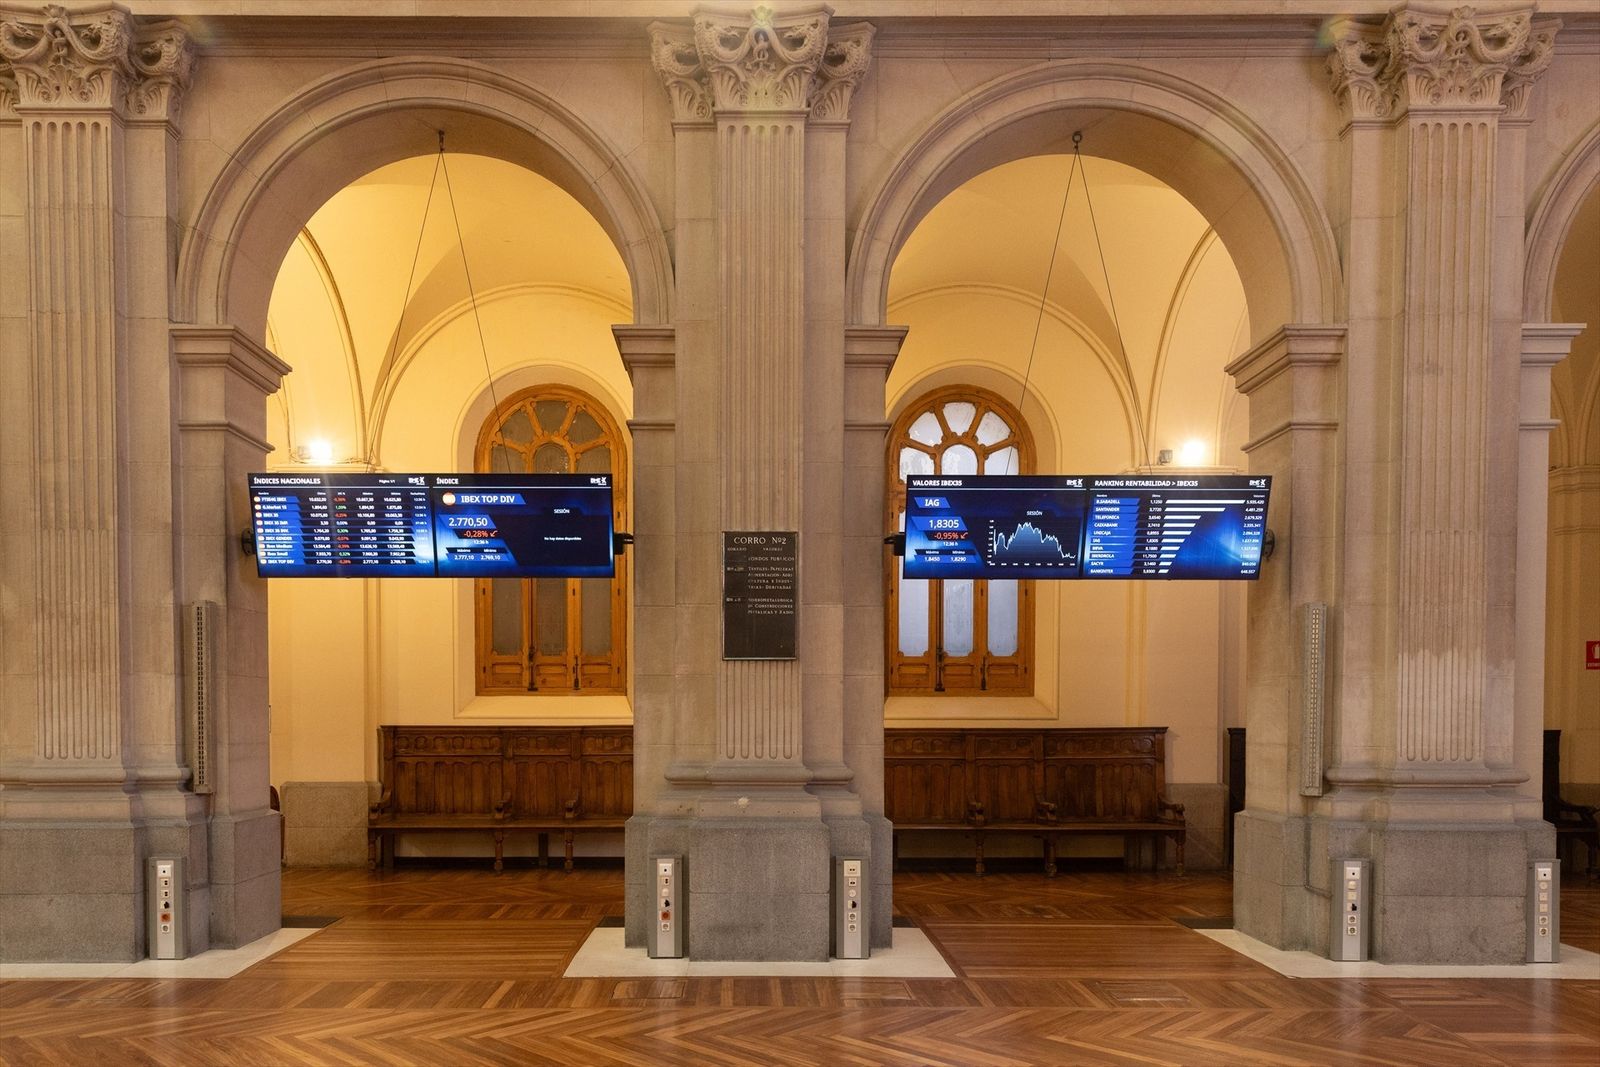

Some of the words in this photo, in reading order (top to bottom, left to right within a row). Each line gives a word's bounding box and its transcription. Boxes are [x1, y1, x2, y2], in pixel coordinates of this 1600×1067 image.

[925, 499, 940, 507] IAG
[449, 517, 488, 527] 2.770,50
[929, 519, 959, 529] 1,8305
